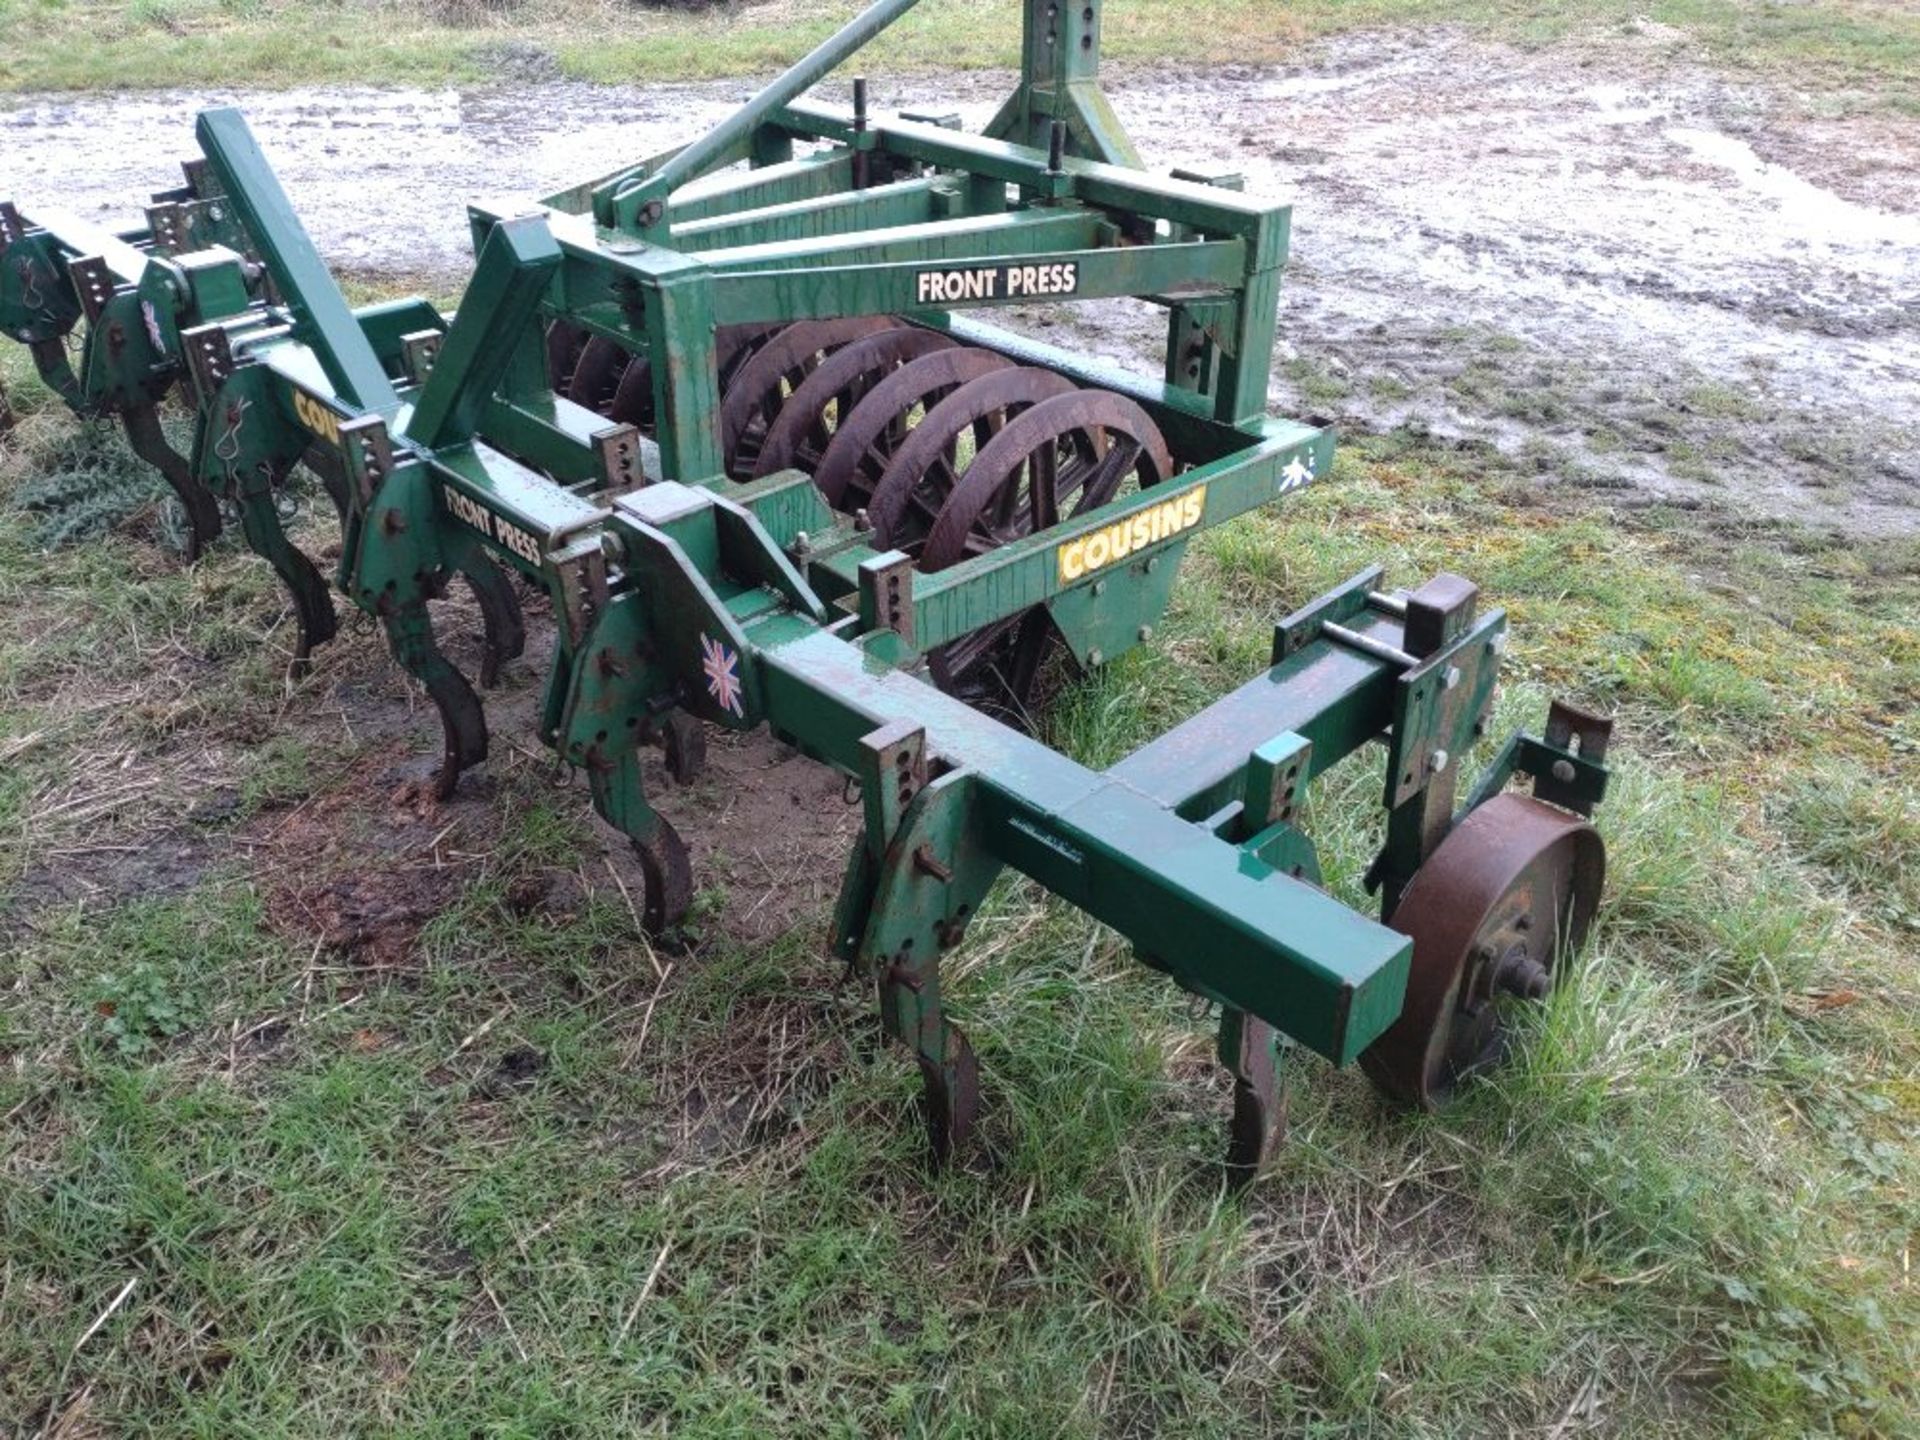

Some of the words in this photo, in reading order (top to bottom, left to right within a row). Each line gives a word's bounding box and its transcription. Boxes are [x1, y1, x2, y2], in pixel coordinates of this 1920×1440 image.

[918, 268, 997, 302] FRONT
[1007, 263, 1076, 296] PRESS
[444, 484, 491, 536] FRONT
[495, 514, 541, 567] PRESS
[1062, 497, 1201, 579] COUSINS
